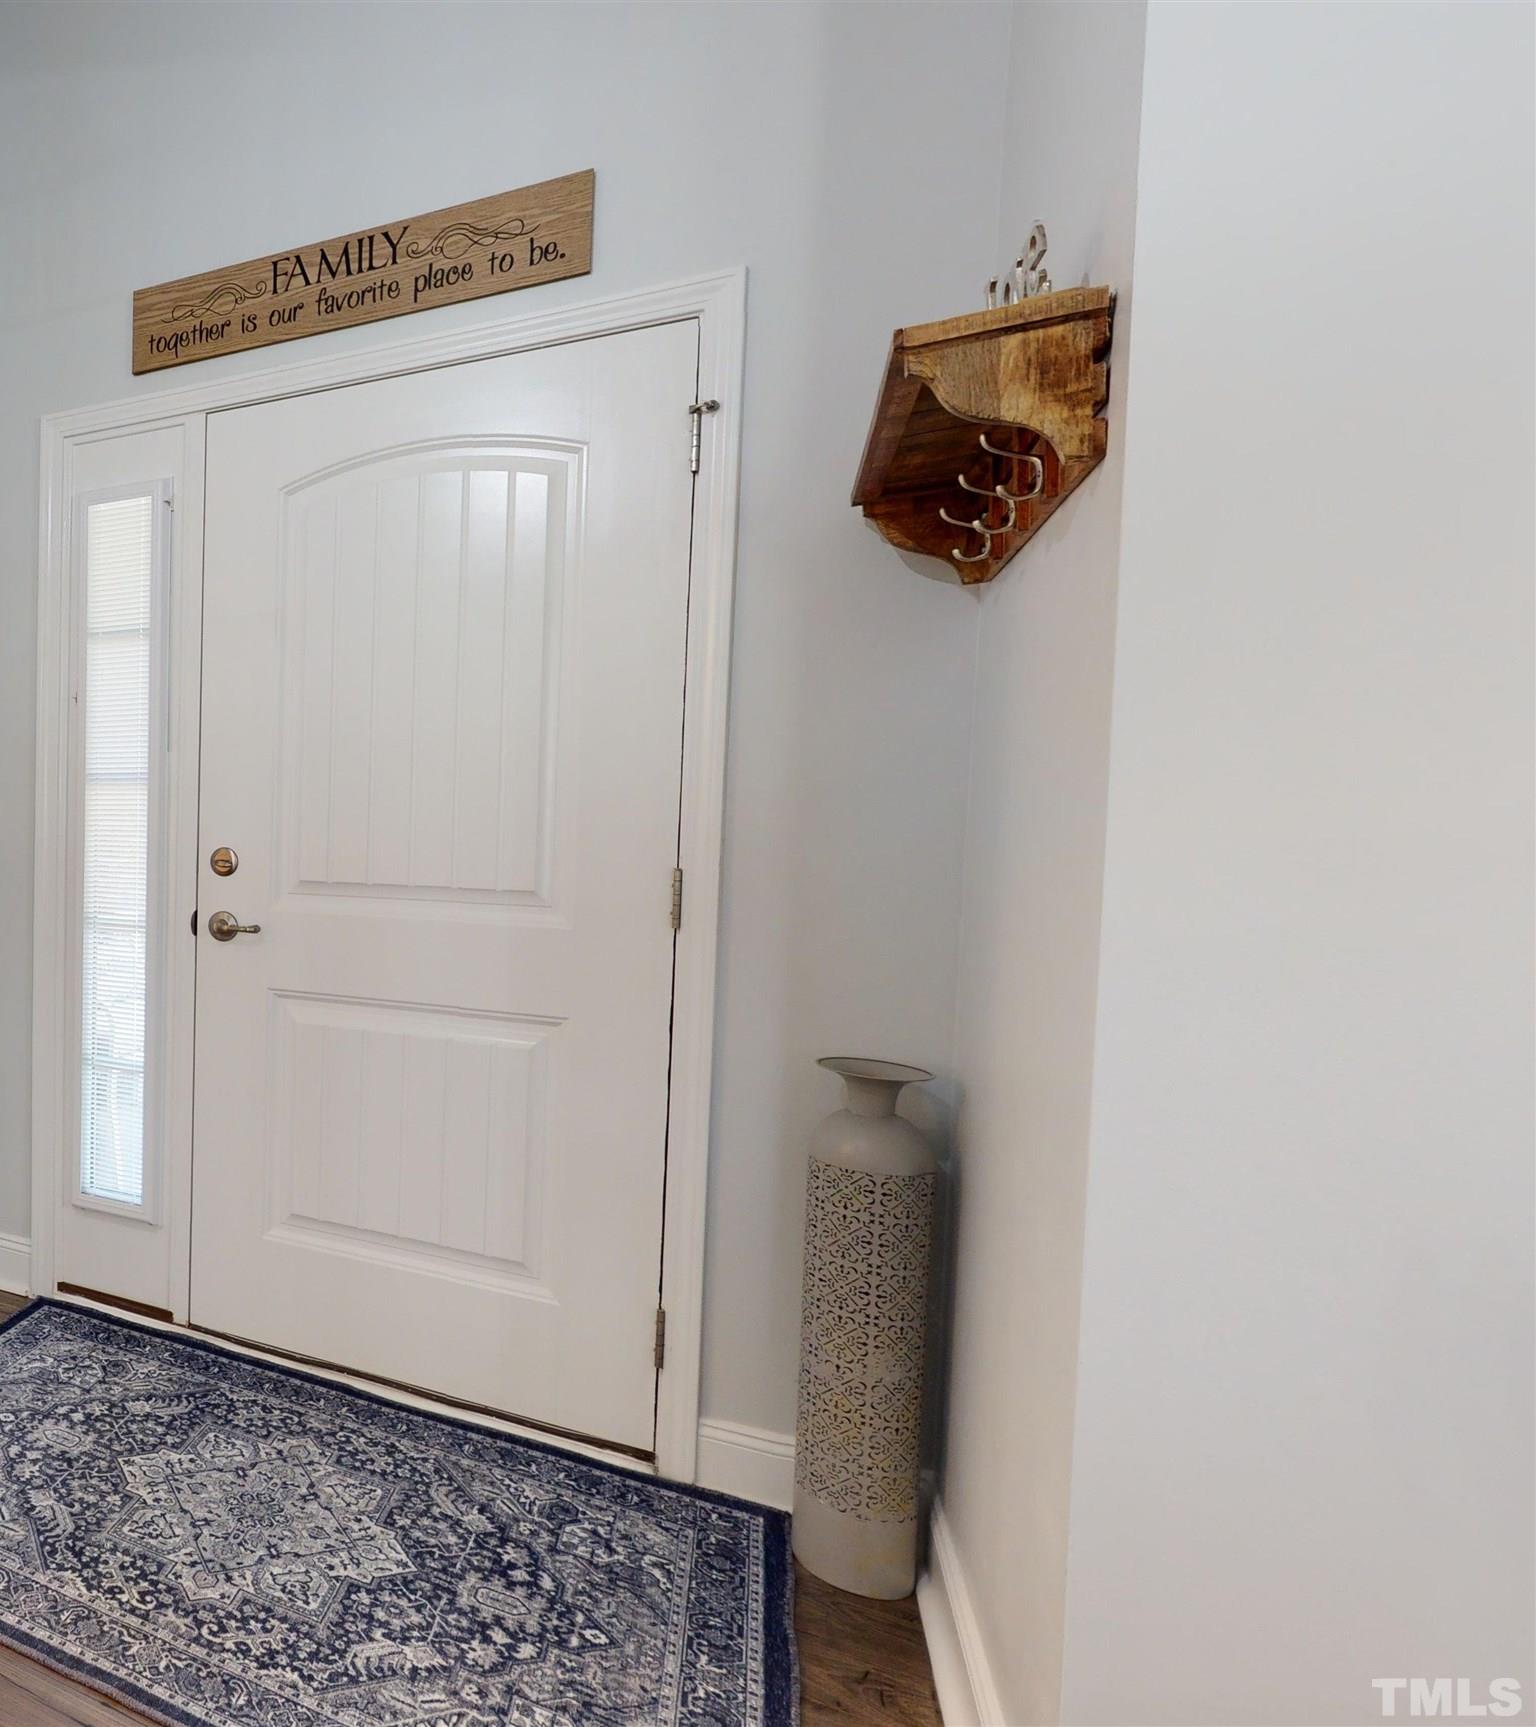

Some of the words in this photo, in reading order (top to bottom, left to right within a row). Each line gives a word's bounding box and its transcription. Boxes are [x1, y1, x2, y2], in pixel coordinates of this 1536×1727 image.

[147, 319, 232, 359] together
[240, 312, 258, 334] is
[268, 301, 305, 327] our
[315, 278, 401, 317] favorite
[413, 262, 474, 304] place
[487, 251, 514, 276] to
[528, 236, 567, 267] be.
[271, 225, 410, 296] FAMILY
